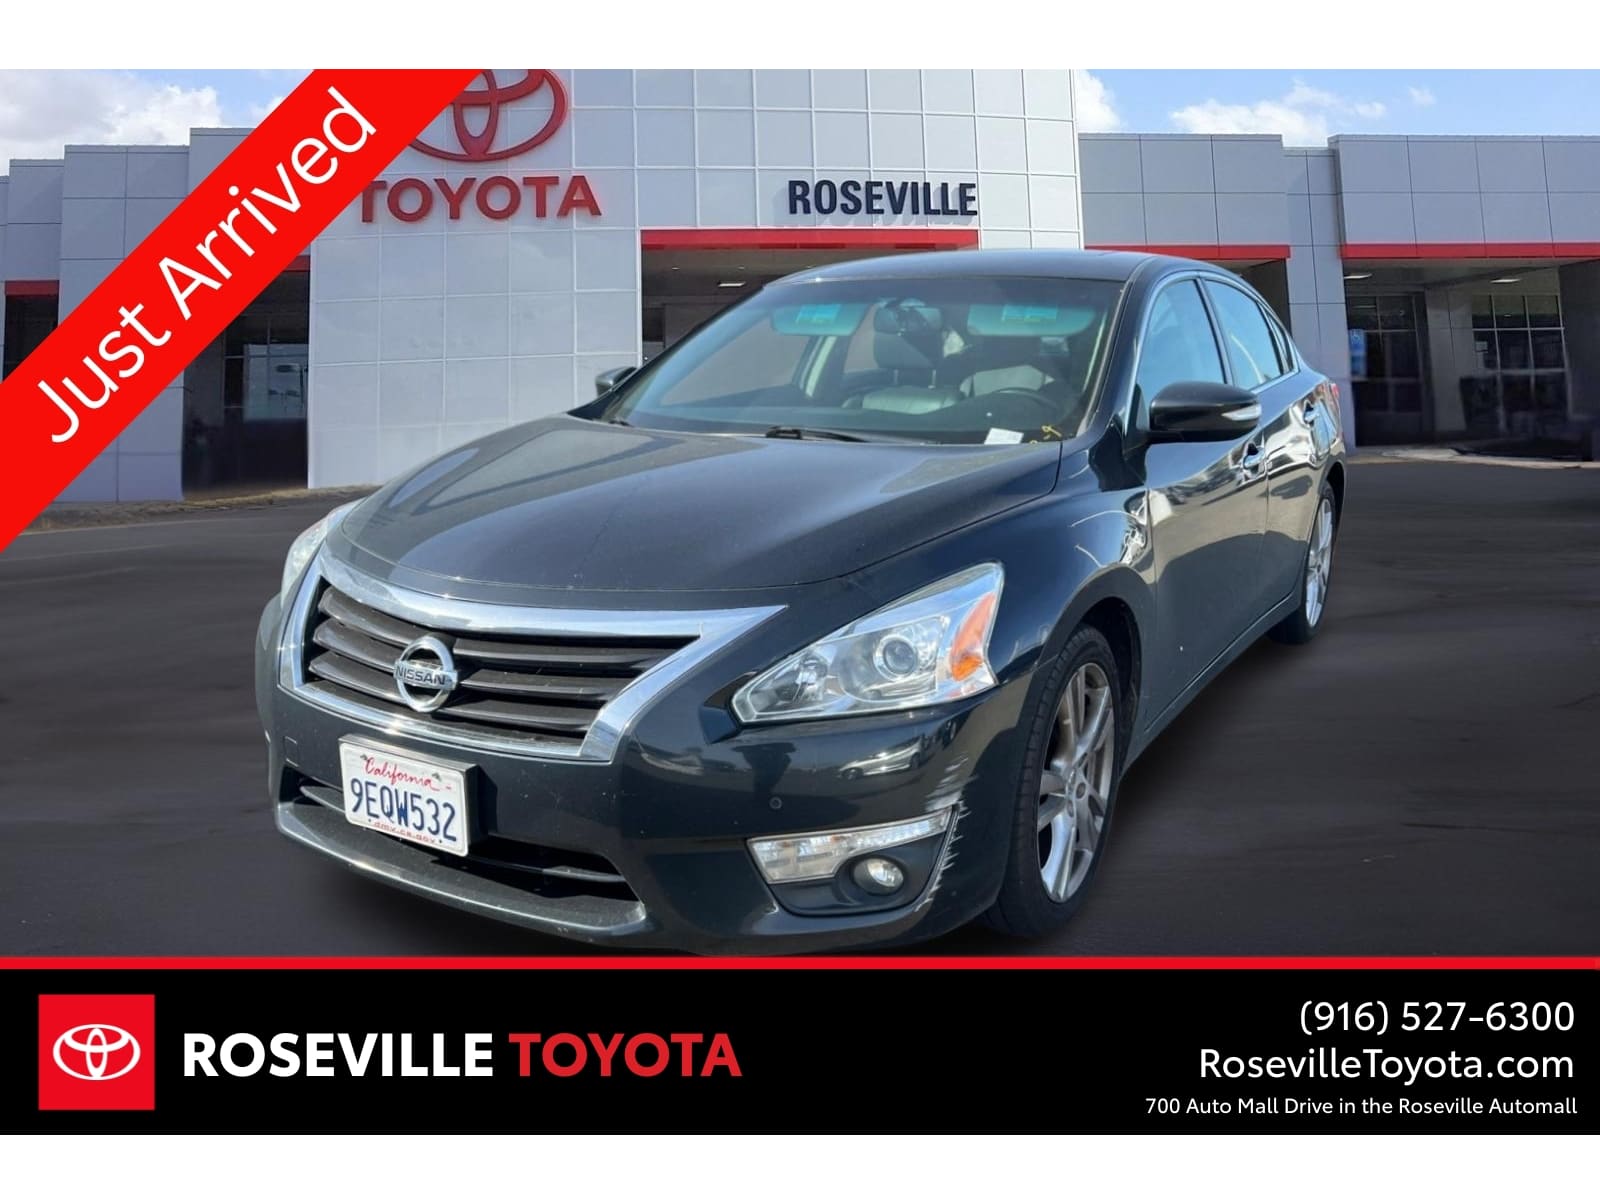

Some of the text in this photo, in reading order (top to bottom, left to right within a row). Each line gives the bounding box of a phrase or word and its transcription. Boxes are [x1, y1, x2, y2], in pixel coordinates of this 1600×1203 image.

[361, 175, 602, 223] TOYOTA
[788, 179, 979, 217] ROSEVILLE
[395, 664, 446, 685] NISSAN
[363, 756, 441, 792] California
[350, 777, 458, 842] 9EQW532
